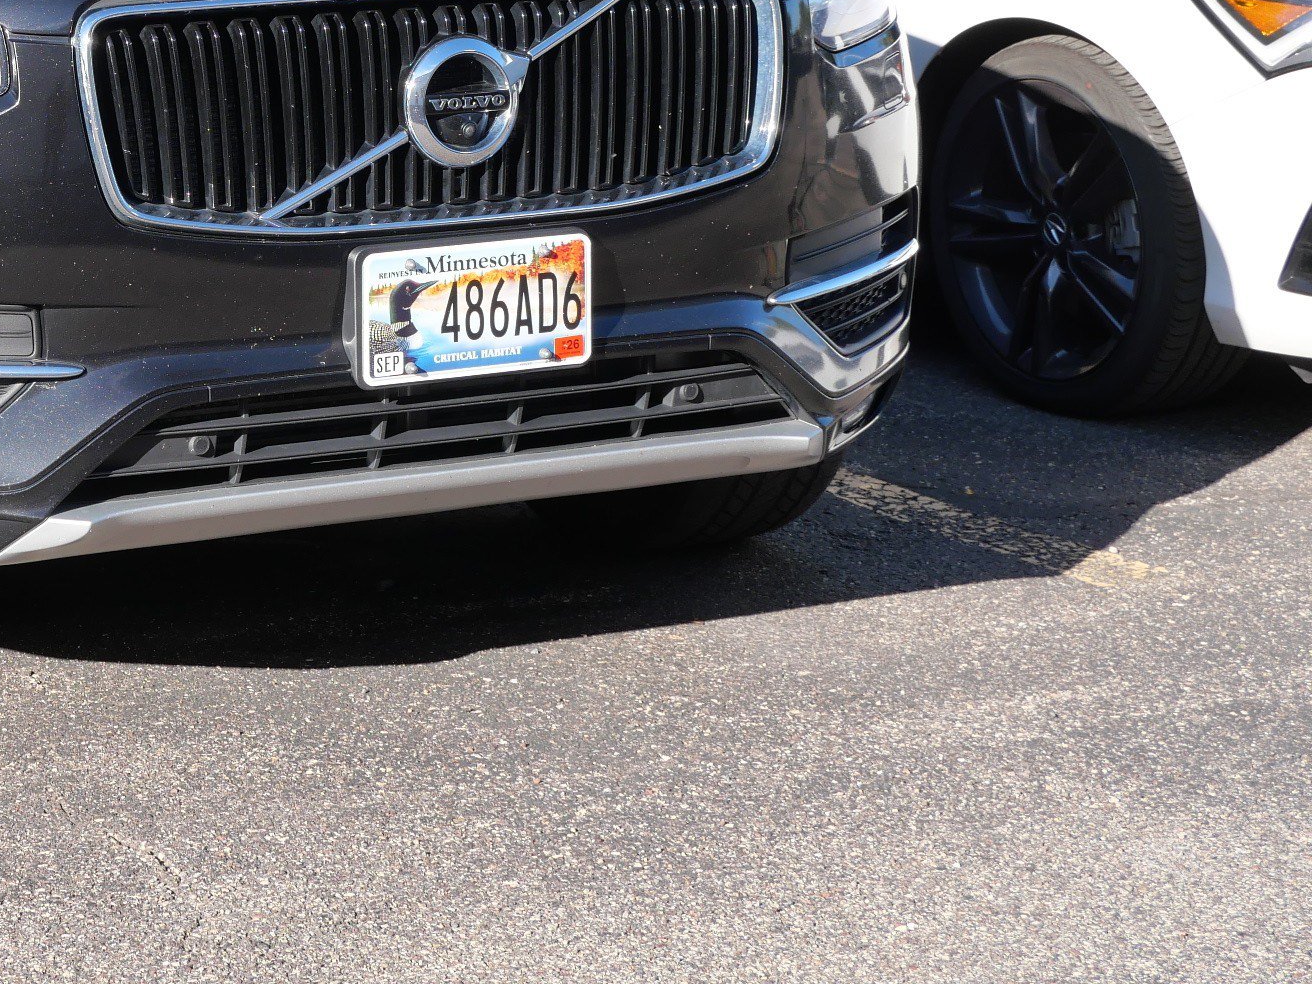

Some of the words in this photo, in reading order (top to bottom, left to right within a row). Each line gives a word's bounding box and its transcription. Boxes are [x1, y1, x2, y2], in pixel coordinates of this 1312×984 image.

[429, 94, 506, 111] VOLVO
[425, 252, 527, 274] Minnesota
[440, 271, 582, 343] 486AD6
[567, 339, 580, 350] 26
[376, 355, 400, 373] SEP
[433, 350, 478, 364] CRITICAL
[480, 347, 522, 359] HABITAT
